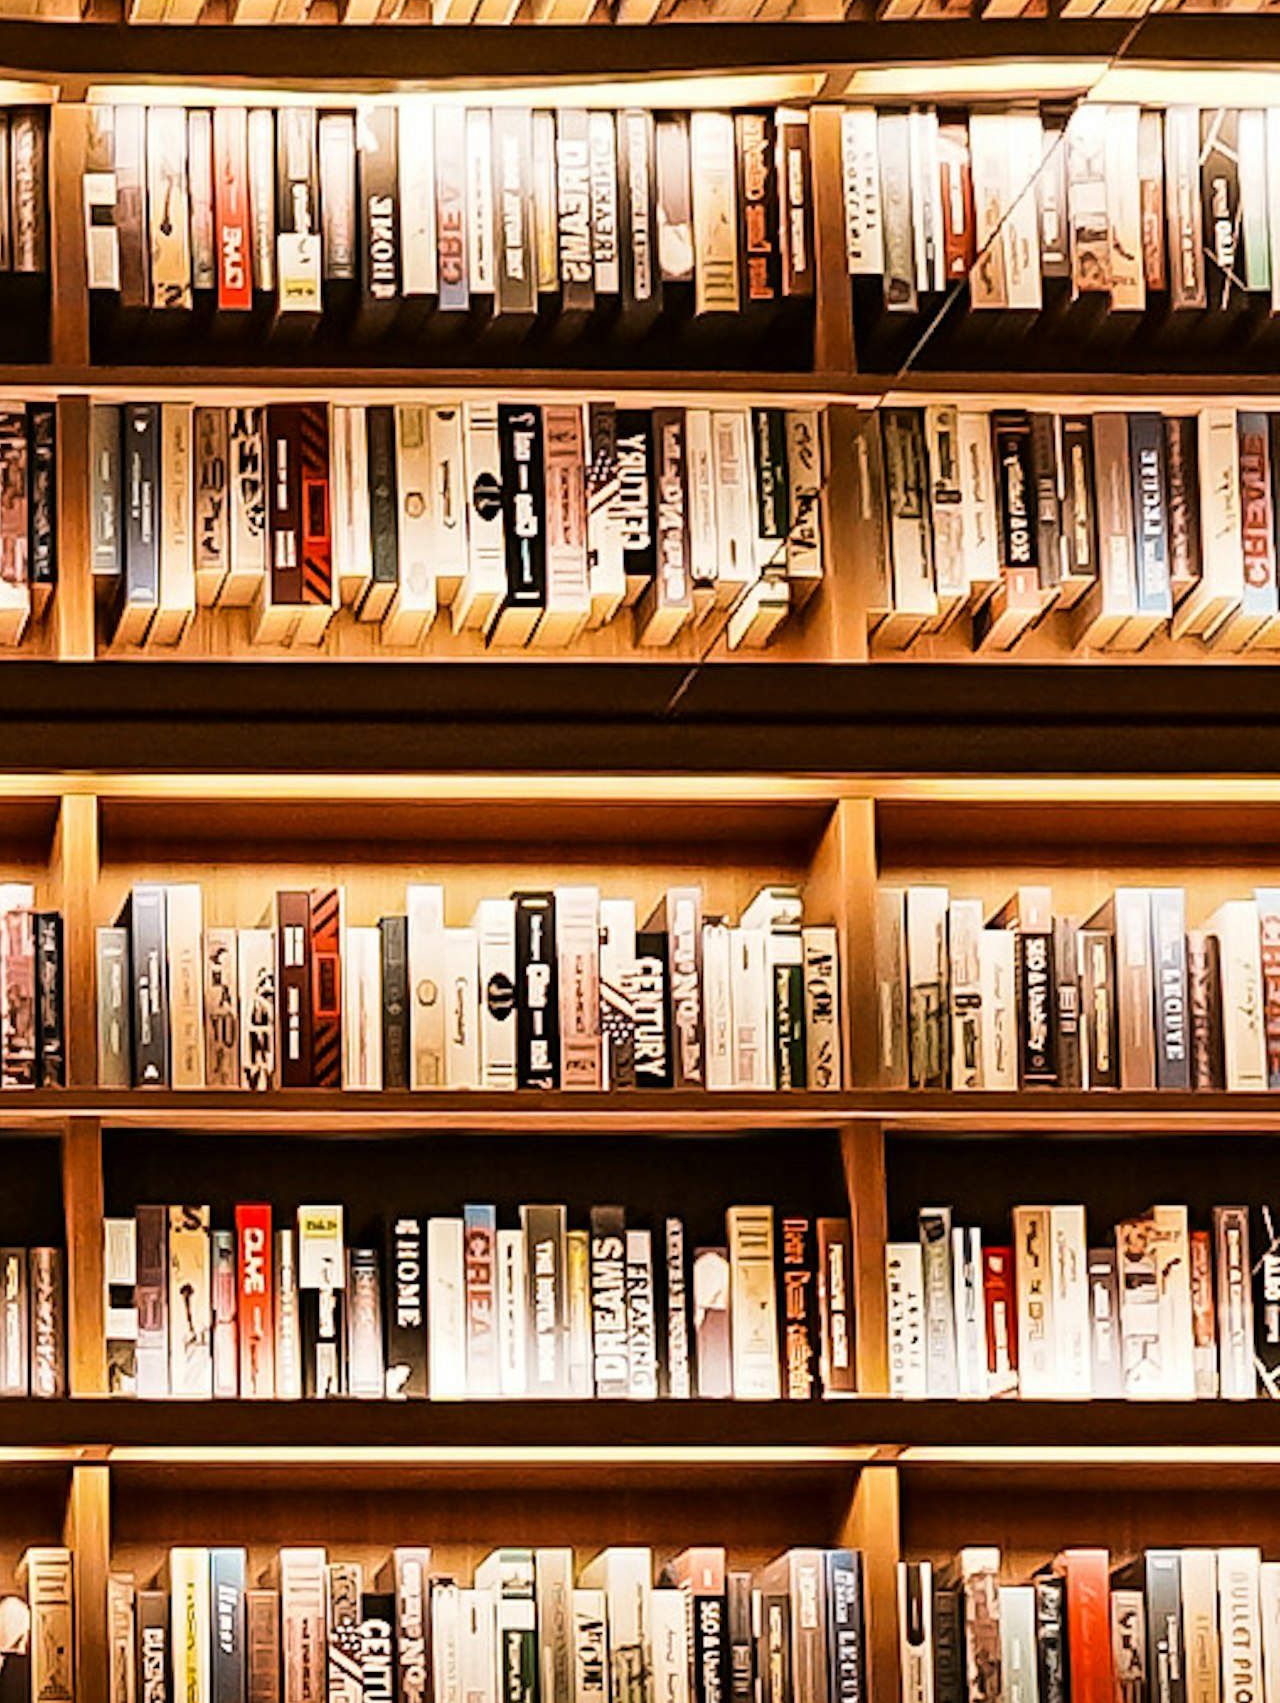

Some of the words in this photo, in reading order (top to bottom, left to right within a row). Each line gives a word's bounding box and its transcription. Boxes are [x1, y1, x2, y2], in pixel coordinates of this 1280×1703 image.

[634, 957, 665, 1076] CENTURY
[397, 1242, 421, 1326] HOME
[627, 1263, 651, 1384] FREAKING
